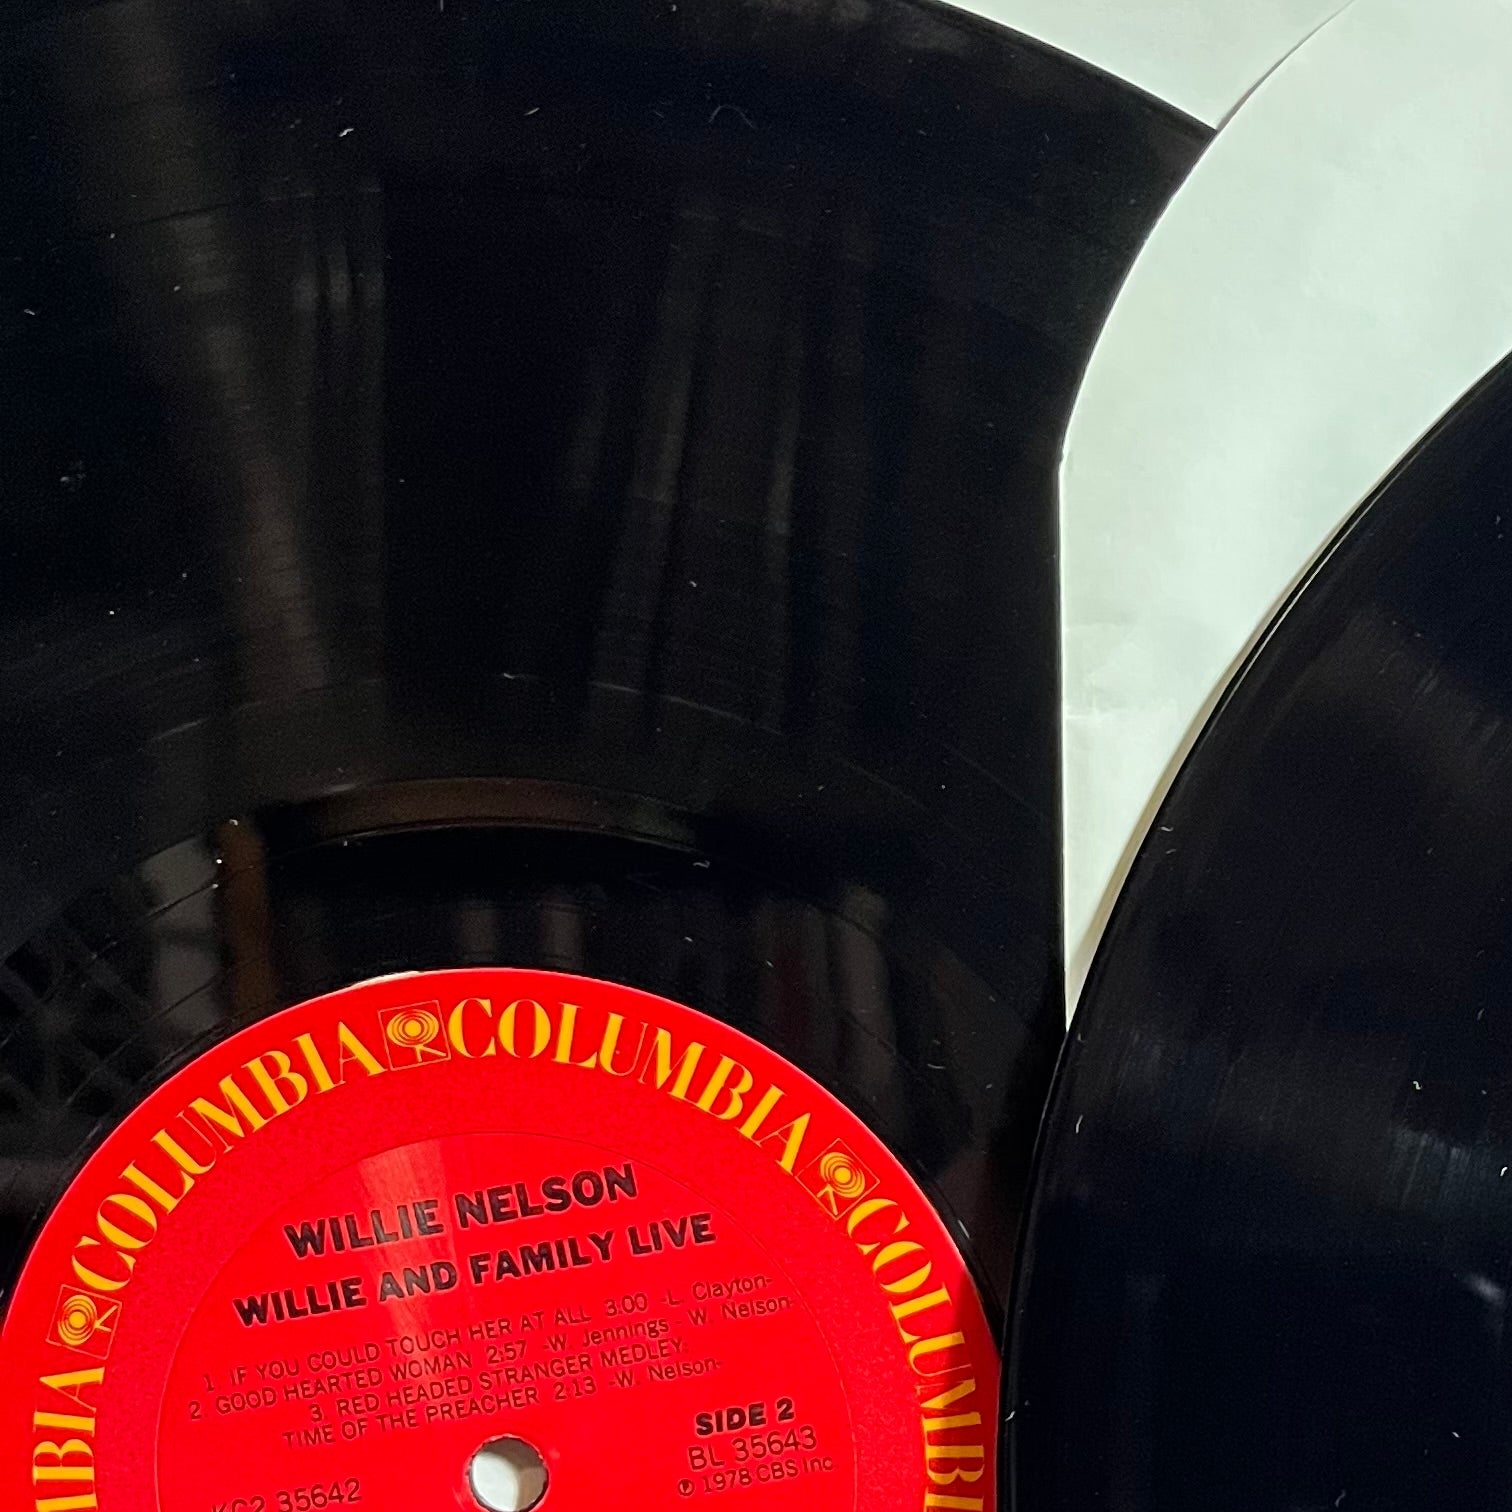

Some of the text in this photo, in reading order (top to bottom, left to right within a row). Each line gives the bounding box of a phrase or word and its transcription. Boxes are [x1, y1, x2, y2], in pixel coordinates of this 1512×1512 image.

[447, 999, 812, 1174] COLUMBIA
[73, 1023, 388, 1291] COLUMBIA
[283, 1163, 638, 1259] WILLIE NELSON
[232, 1212, 717, 1327] WILLIE AND FAMILY LIVE
[215, 1318, 669, 1415] GOOD HEARTED WOMAN 2:57 Jennings
[229, 1305, 593, 1386] IF YOU COULD TOUCH HER AT ALL
[336, 1353, 593, 1417] RED HEADED STRANGER
[281, 1386, 540, 1449] TIME OF THE PREACHER
[688, 1425, 817, 1471] BL 35643
[695, 1397, 795, 1436] SIDE 2
[702, 1459, 799, 1493] 1978 CBS
